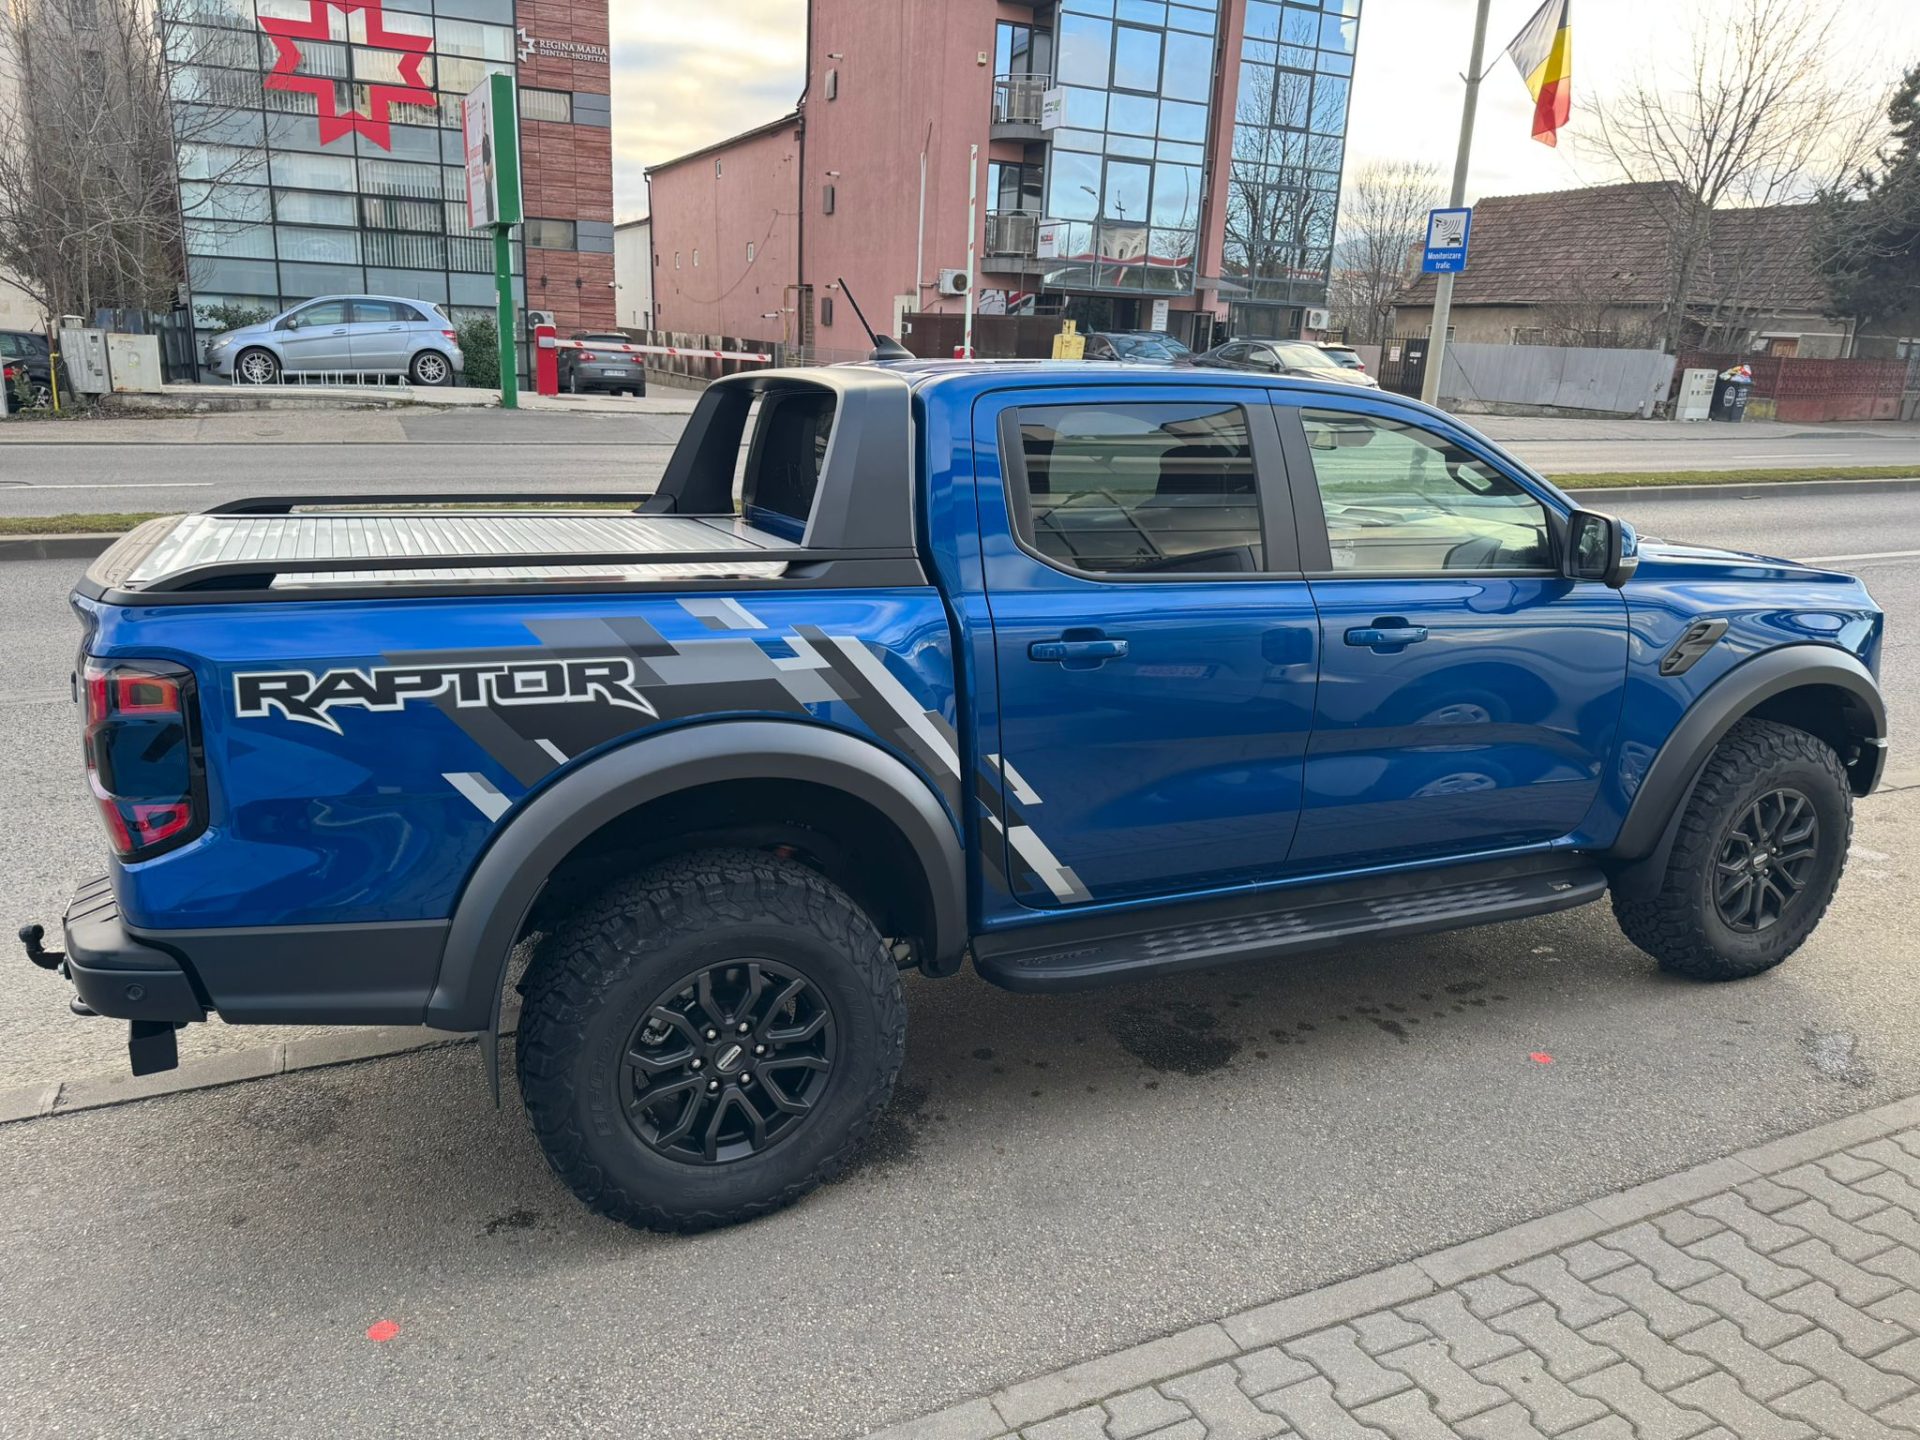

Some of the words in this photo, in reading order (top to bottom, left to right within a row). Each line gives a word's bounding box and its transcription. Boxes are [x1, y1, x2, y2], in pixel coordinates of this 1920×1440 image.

[539, 40, 575, 52] REGINA
[576, 44, 608, 56] MARIA
[540, 49, 569, 58] DENTAL
[571, 53, 608, 63] HOSPITAL
[1427, 252, 1462, 260] Monitorizare
[1435, 261, 1451, 269] trafic
[232, 657, 660, 736] RAPTOR
